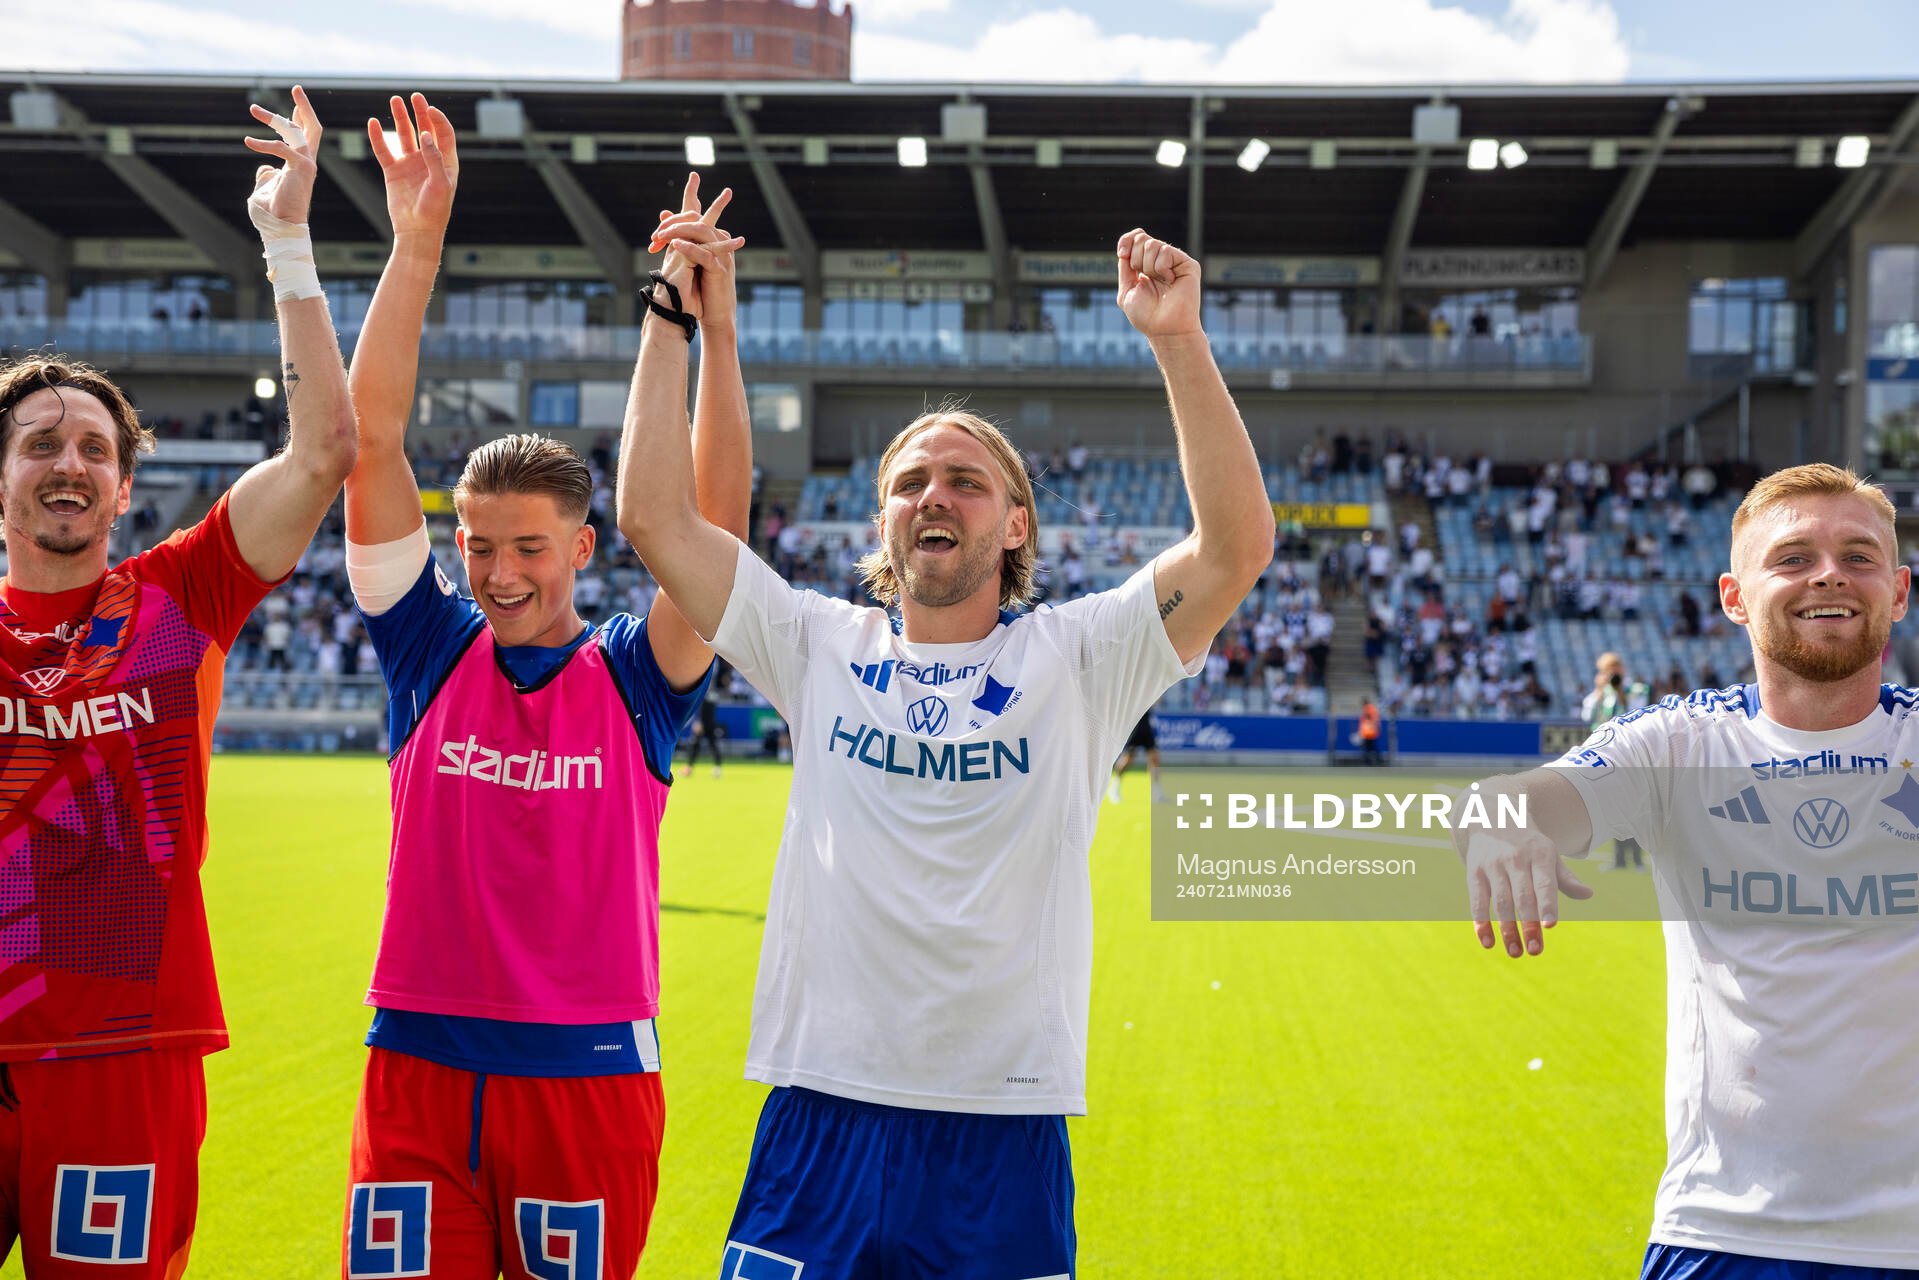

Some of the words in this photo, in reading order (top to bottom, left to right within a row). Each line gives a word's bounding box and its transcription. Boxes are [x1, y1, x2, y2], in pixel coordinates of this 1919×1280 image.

[437, 735, 602, 791] stadium
[829, 715, 1030, 782] HOLMEN
[1751, 750, 1888, 781] stadium
[1006, 1076, 1040, 1084] AEROREADY
